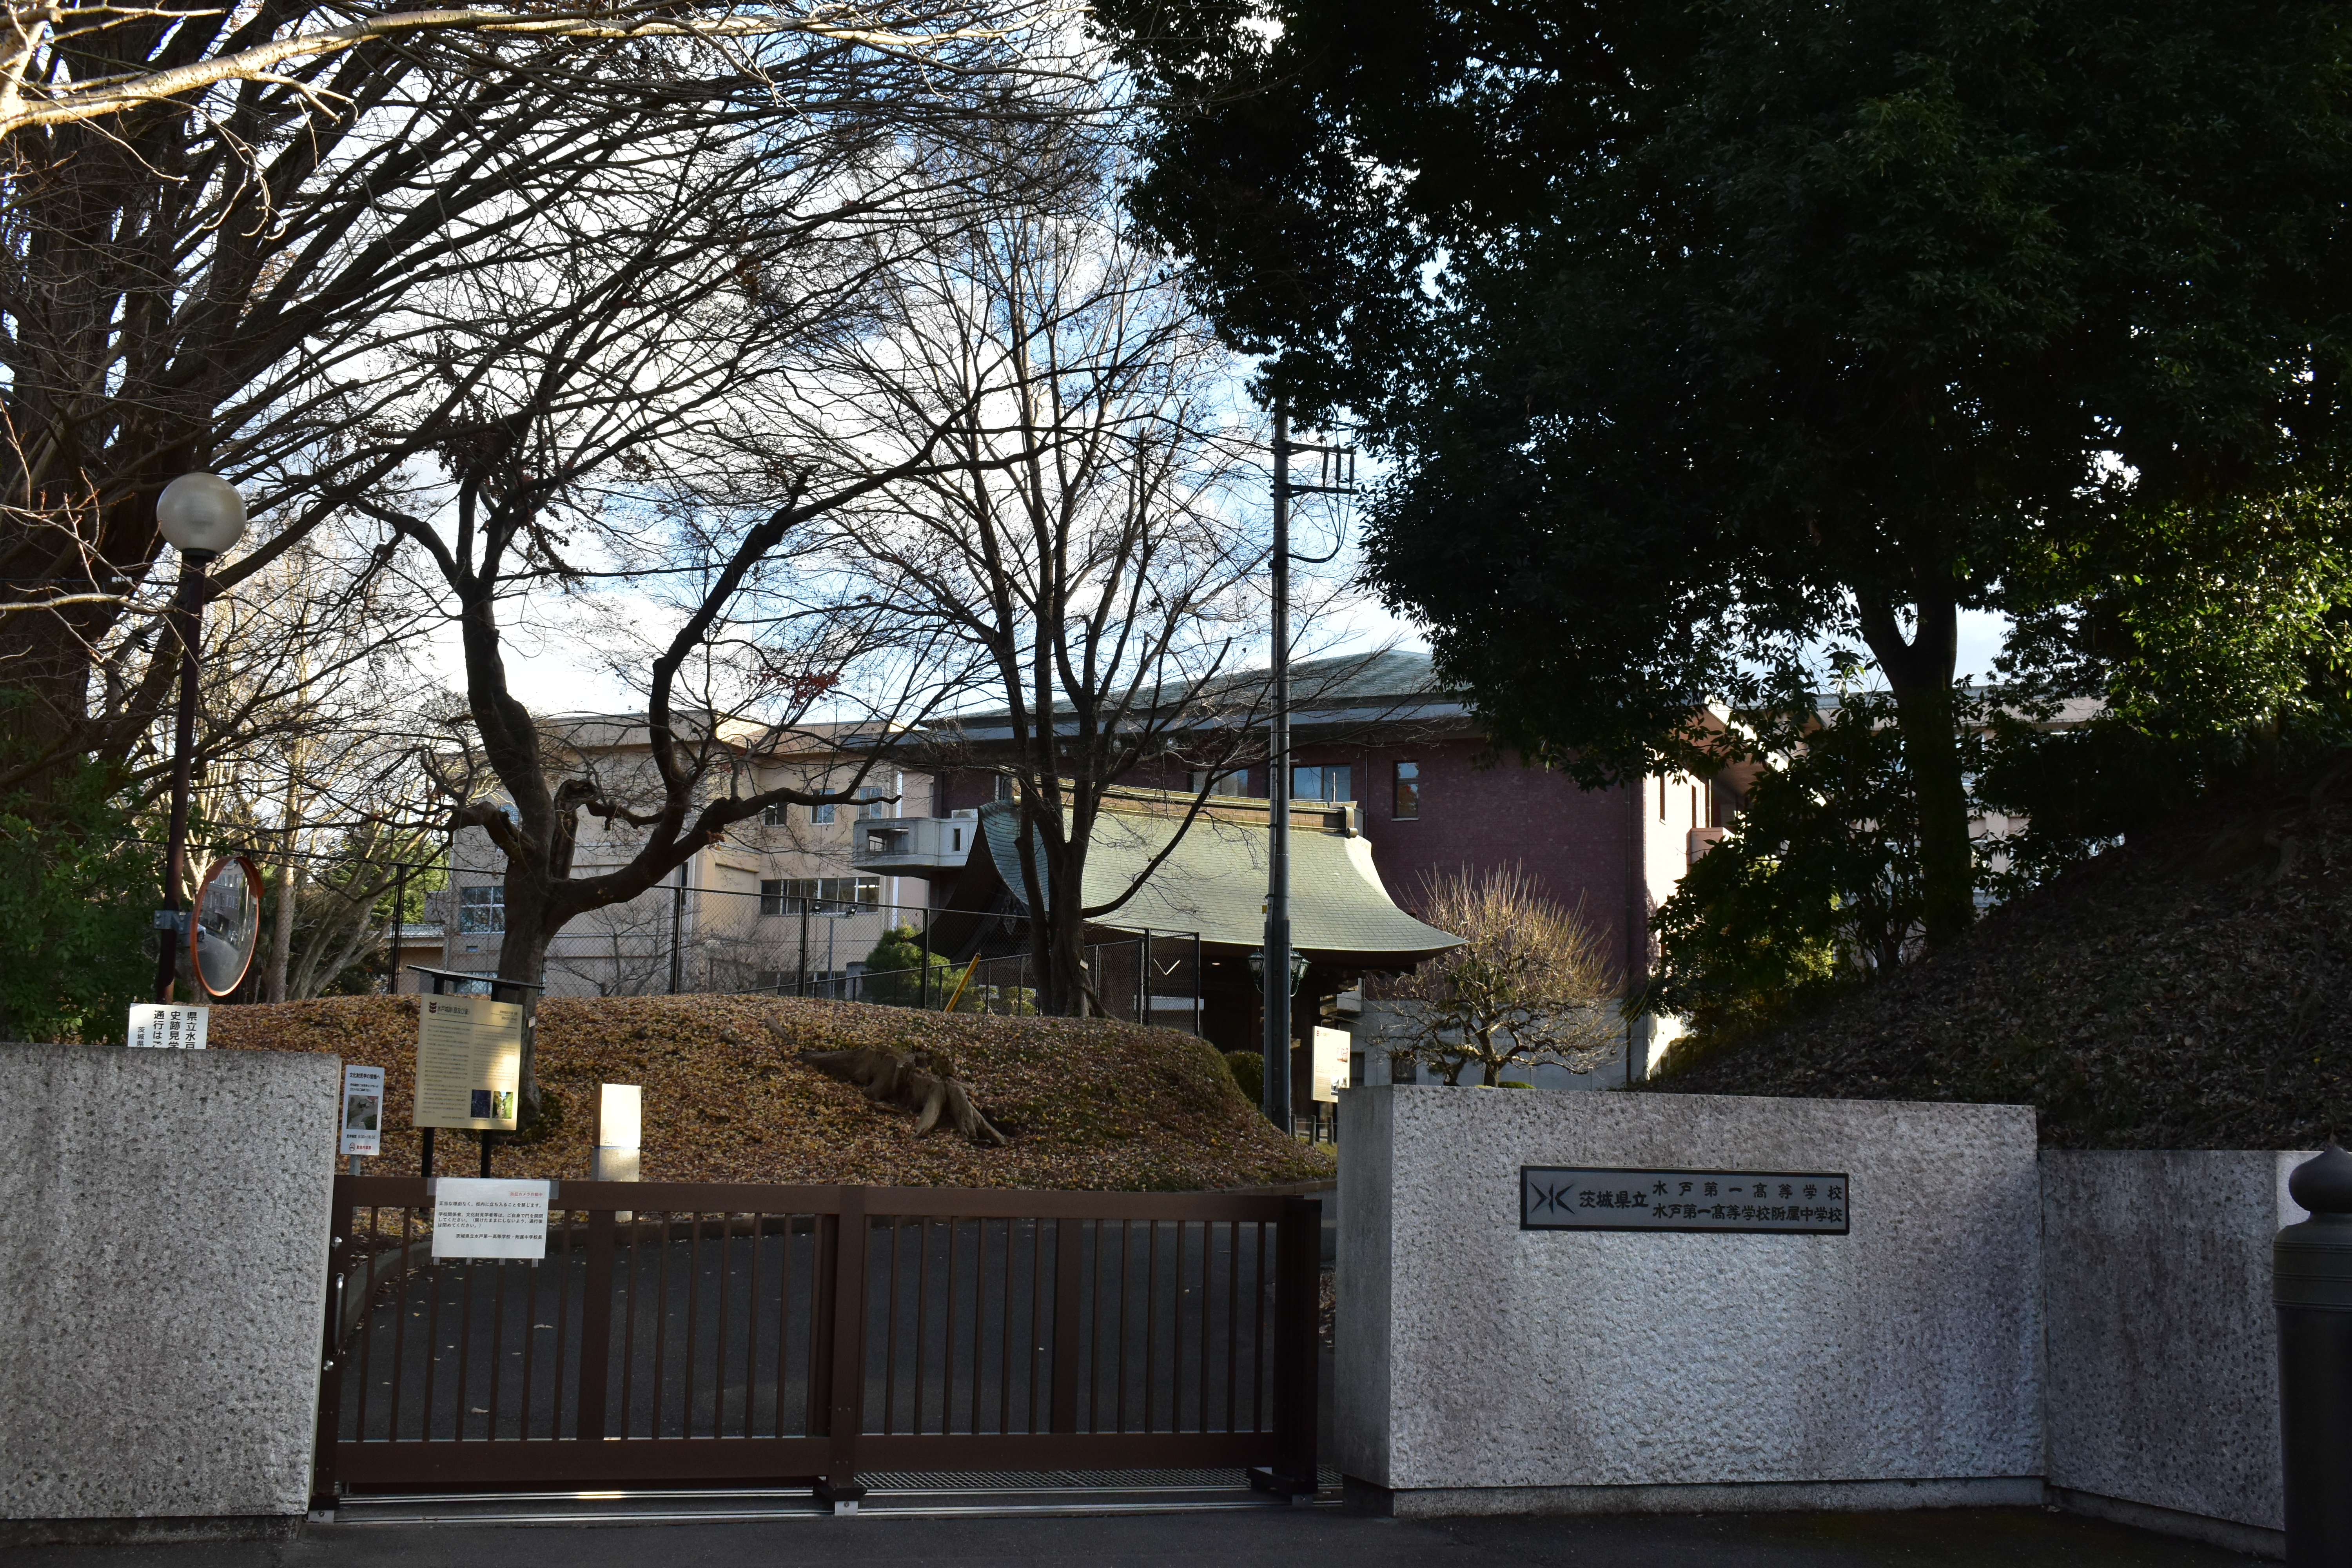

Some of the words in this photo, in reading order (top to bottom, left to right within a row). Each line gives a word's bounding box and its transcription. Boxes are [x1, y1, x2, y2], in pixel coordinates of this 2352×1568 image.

[137, 1026, 145, 1047] 茨城県
[168, 1011, 181, 1048] 史跡見学
[1579, 1190, 1648, 1209] 茨城県立
